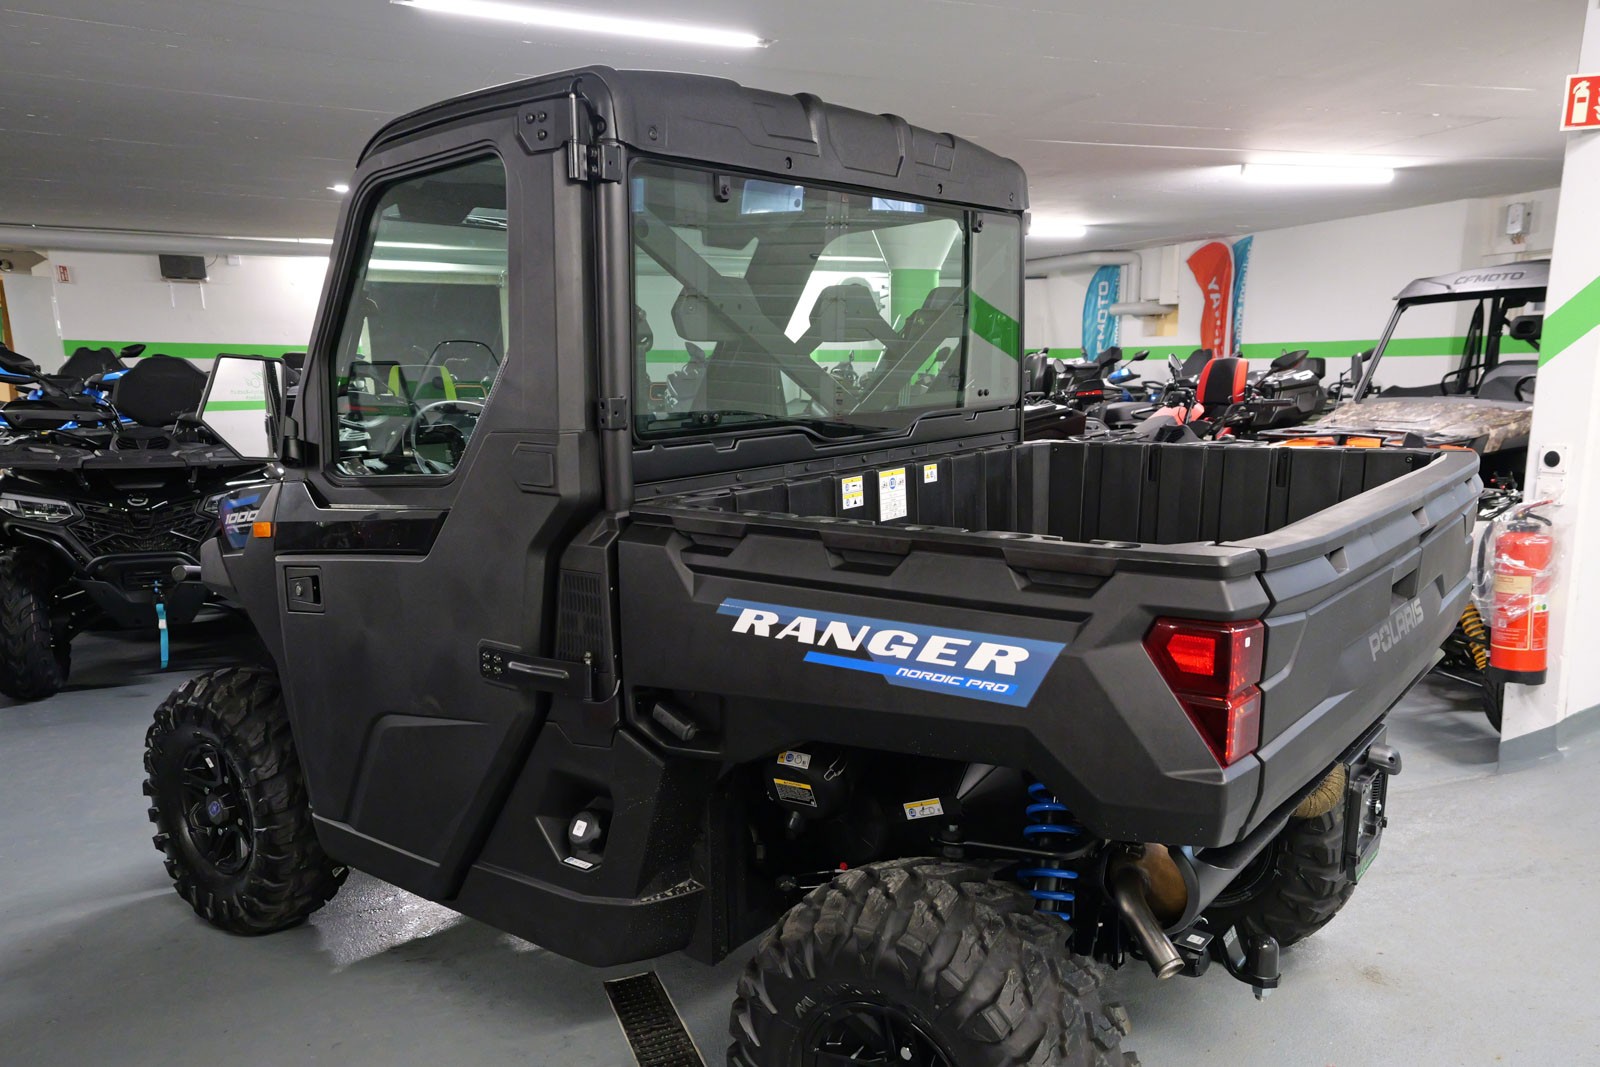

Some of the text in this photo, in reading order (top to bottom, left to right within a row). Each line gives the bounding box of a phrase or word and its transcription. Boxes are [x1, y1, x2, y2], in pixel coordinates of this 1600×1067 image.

[1453, 271, 1525, 285] CFMOTO
[225, 510, 260, 525] 1000
[731, 608, 1030, 676] RANGER
[1368, 598, 1424, 662] POLARIS
[895, 667, 1010, 693] NORDIC PRO
